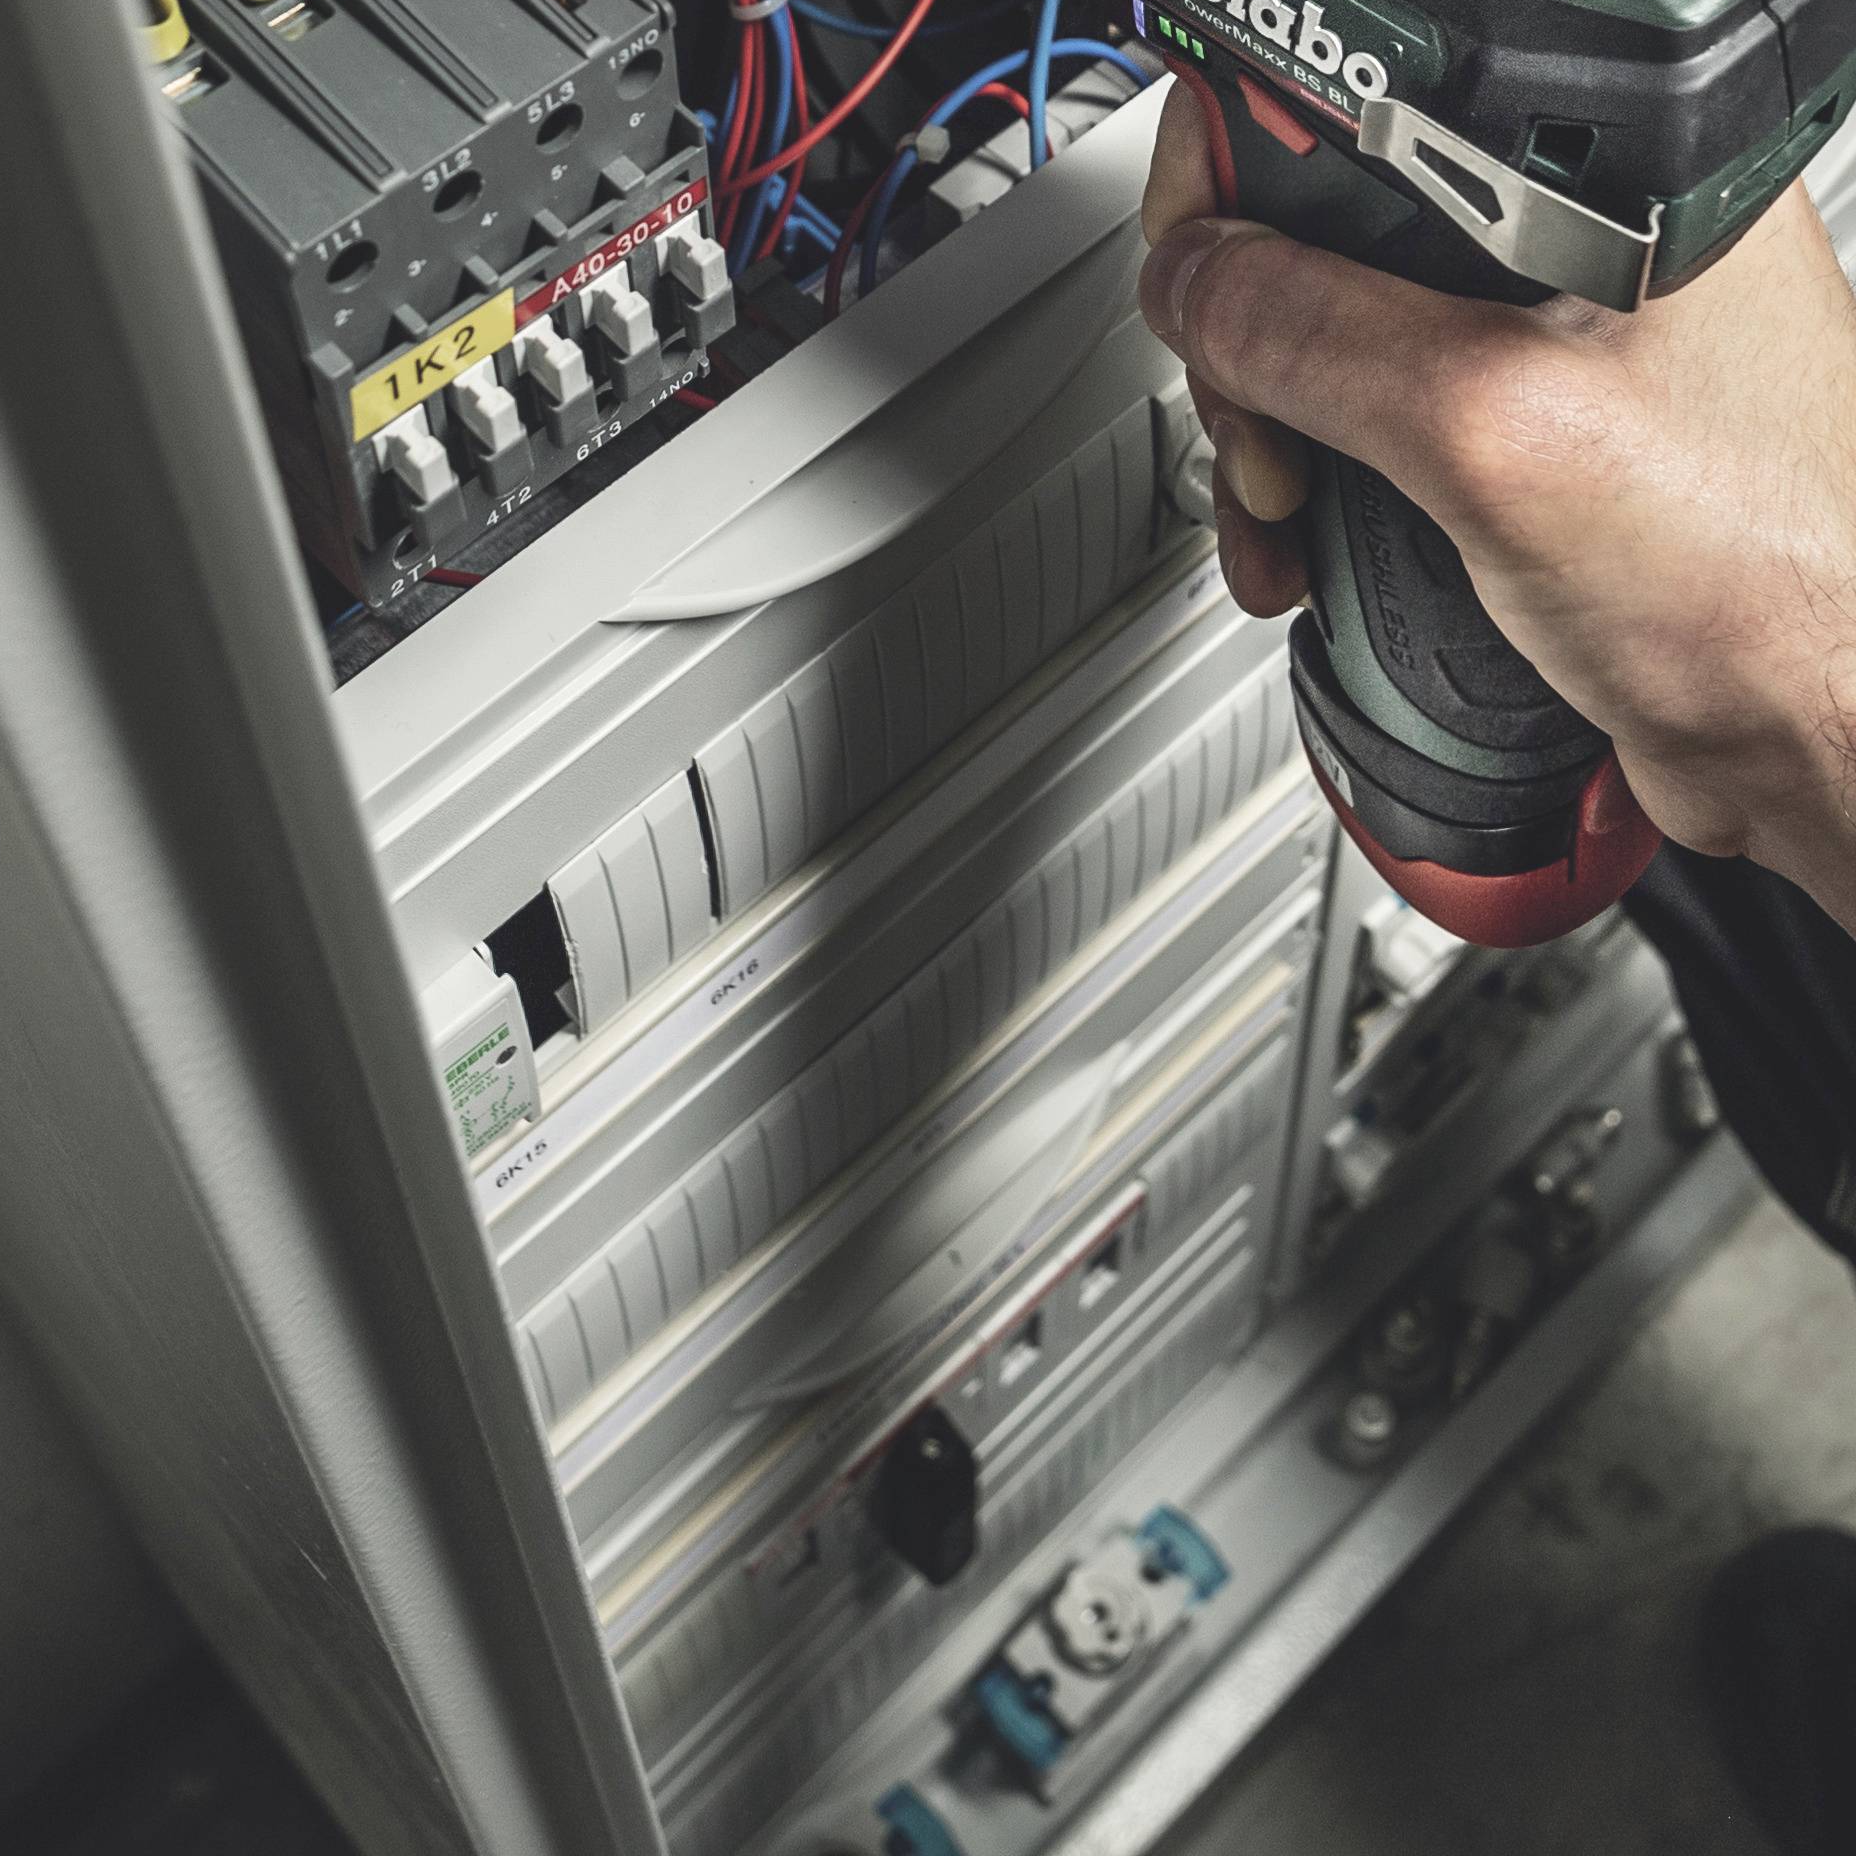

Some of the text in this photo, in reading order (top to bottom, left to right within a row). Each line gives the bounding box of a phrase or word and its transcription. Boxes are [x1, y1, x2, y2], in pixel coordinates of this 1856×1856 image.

[608, 29, 660, 70] 13NO
[527, 80, 576, 124] 5L3
[1294, 66, 1322, 93] BS
[1328, 86, 1355, 115] BL
[422, 147, 473, 192] 3L2
[316, 219, 363, 262] 1L1
[551, 192, 693, 303] A40-30-10
[384, 324, 477, 400] 1K2
[649, 371, 694, 408] 14NO
[576, 420, 622, 461] 6T3
[486, 485, 532, 527] 4T2
[391, 554, 438, 598] 2T1
[445, 1026, 511, 1083] EBERLE
[495, 958, 759, 1188] 6K15 6K16
